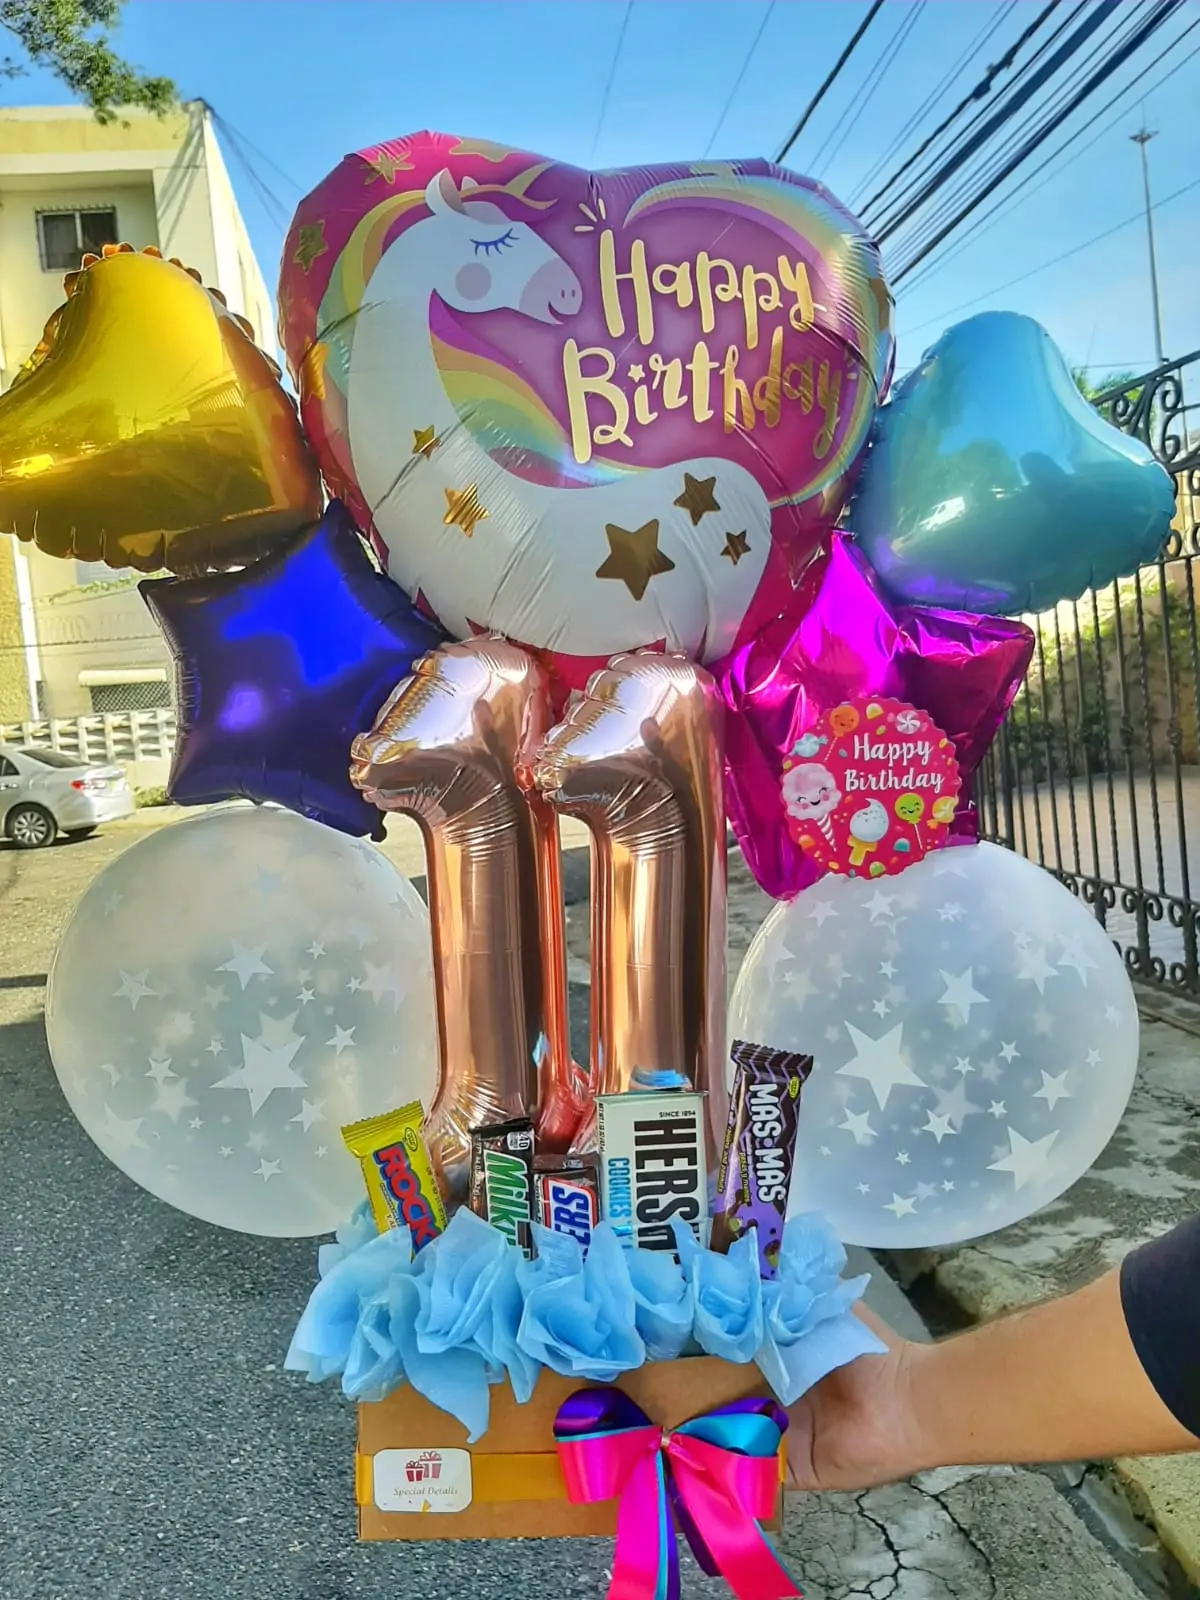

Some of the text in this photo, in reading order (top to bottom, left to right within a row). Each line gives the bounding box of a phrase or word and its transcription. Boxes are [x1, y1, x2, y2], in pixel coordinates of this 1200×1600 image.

[600, 228, 823, 349] Happy
[563, 326, 842, 464] Birthday
[852, 732, 934, 767] Happy
[844, 767, 945, 794] Birthday
[658, 1110, 680, 1118] SINCE
[608, 1157, 632, 1218] COOKIES
[634, 1118, 700, 1260] HERSH
[393, 1485, 459, 1496] Special Details
